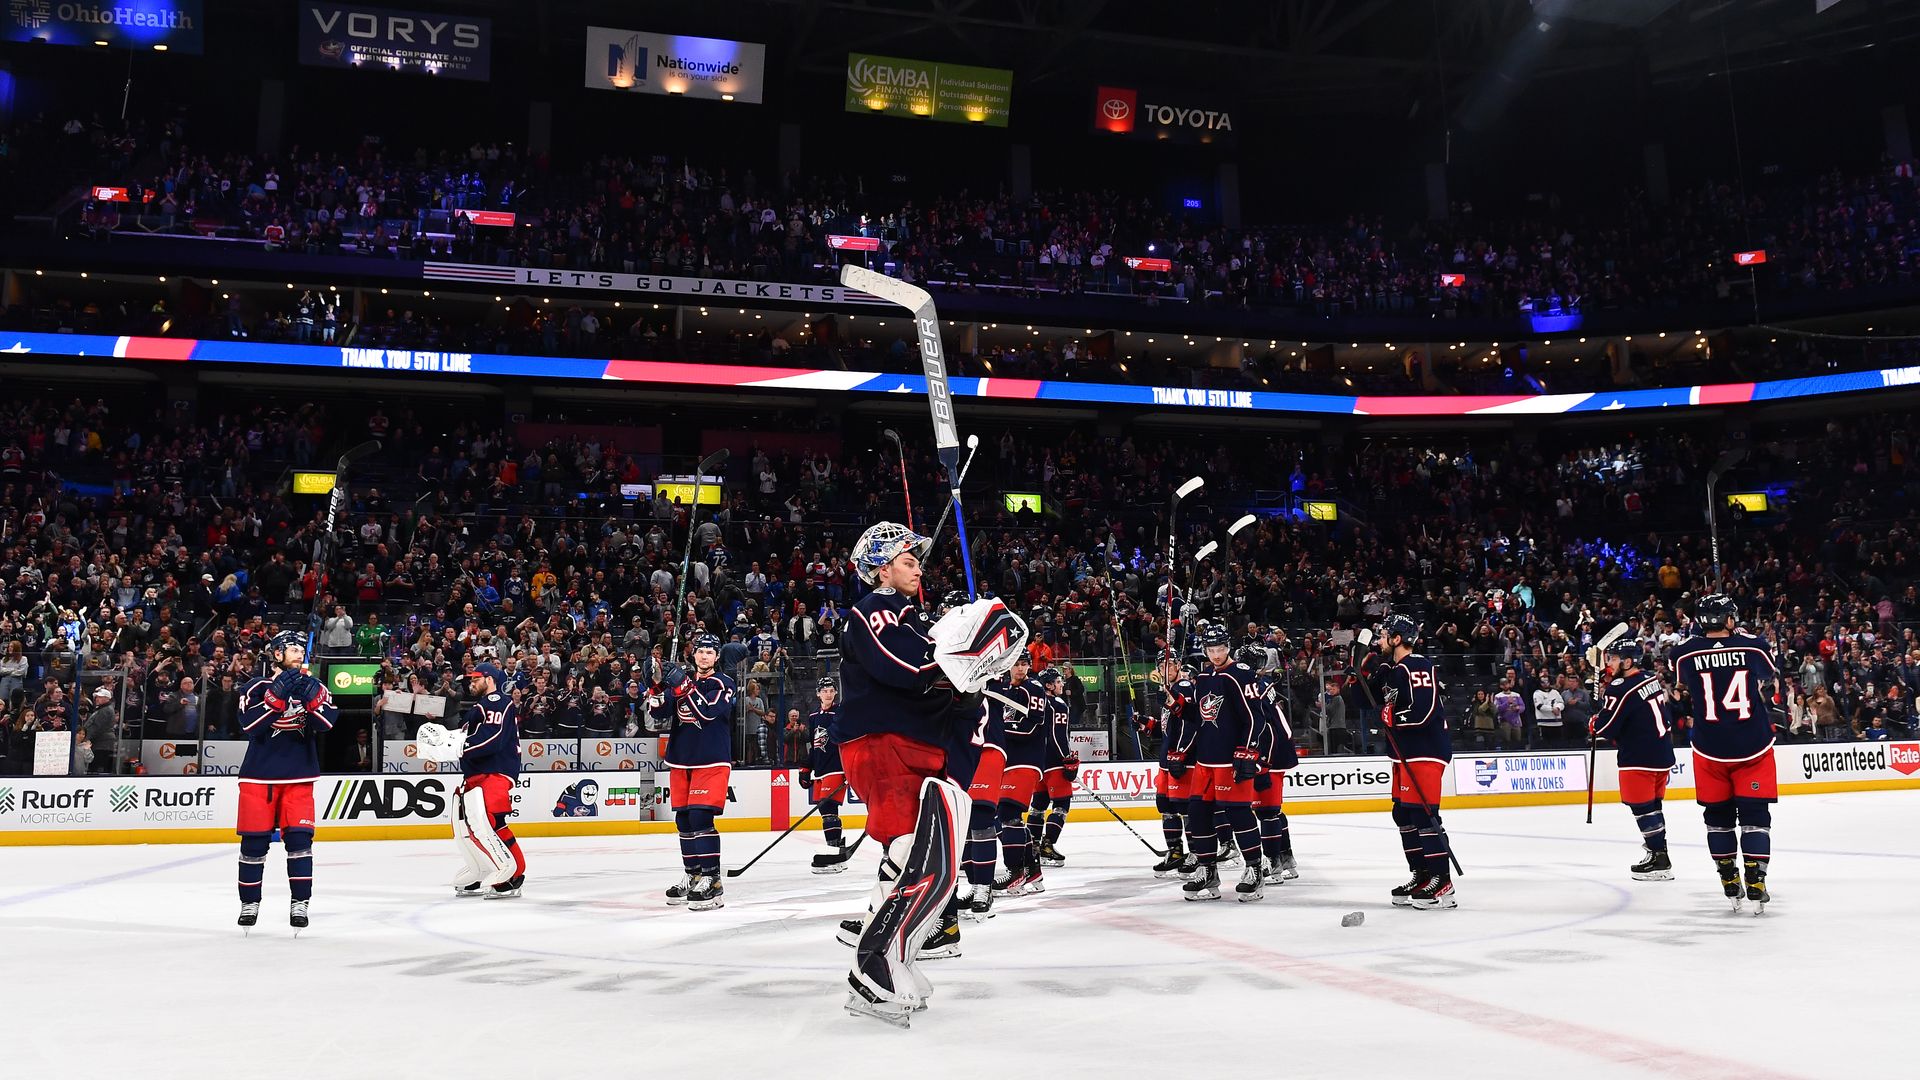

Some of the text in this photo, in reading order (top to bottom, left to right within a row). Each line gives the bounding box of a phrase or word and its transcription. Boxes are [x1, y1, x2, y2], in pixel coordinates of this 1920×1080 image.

[57, 3, 193, 29] OhioHealth
[311, 8, 480, 49] VORYS
[350, 44, 471, 63] OFFICIAL CORPORATE AND
[353, 52, 467, 71] BUSINESS LAW PARTNER
[657, 55, 740, 75] Nationwide
[669, 69, 728, 83] is on your side
[863, 64, 930, 89] KEMBA
[875, 85, 929, 98] FINANCIAL
[940, 78, 1009, 92] Individual Solutions
[905, 96, 929, 104] UNION
[939, 90, 1004, 103] Outstanding Rates
[858, 98, 882, 107] better
[883, 101, 899, 110] way
[900, 102, 908, 110] to
[910, 103, 929, 112] bank
[938, 102, 983, 113] Personalized
[1144, 104, 1232, 131] TOYOTA
[1186, 199, 1199, 207] 205
[527, 270, 834, 302] LET'S GO JACKETS
[340, 348, 472, 373] THANK YOU 5TH LINE
[1151, 387, 1253, 409] THANK YOU 5TH LINE
[305, 475, 334, 484] KEMBA
[678, 485, 705, 495] KEMA
[869, 609, 899, 637] 90
[1693, 651, 1747, 671] NYQUIST
[1078, 675, 1098, 684] nergy
[1411, 671, 1432, 688] 52
[1603, 695, 1617, 711] 17
[1699, 669, 1752, 722] 14
[1030, 696, 1045, 712] 59
[485, 710, 502, 725] 30
[1055, 712, 1067, 724] 22
[614, 742, 647, 755] PNC
[1505, 757, 1567, 772] SLOW DOWN IN
[1803, 744, 1920, 780] guaranteed Rate
[1283, 768, 1390, 790] nterprise
[1510, 776, 1565, 791] WORK ZONES
[22, 789, 95, 809] Ruoff
[145, 787, 216, 808] Ruoff
[347, 778, 446, 820] ADS
[20, 812, 92, 824] MORTGAGE
[144, 810, 215, 822] MORTGAGE
